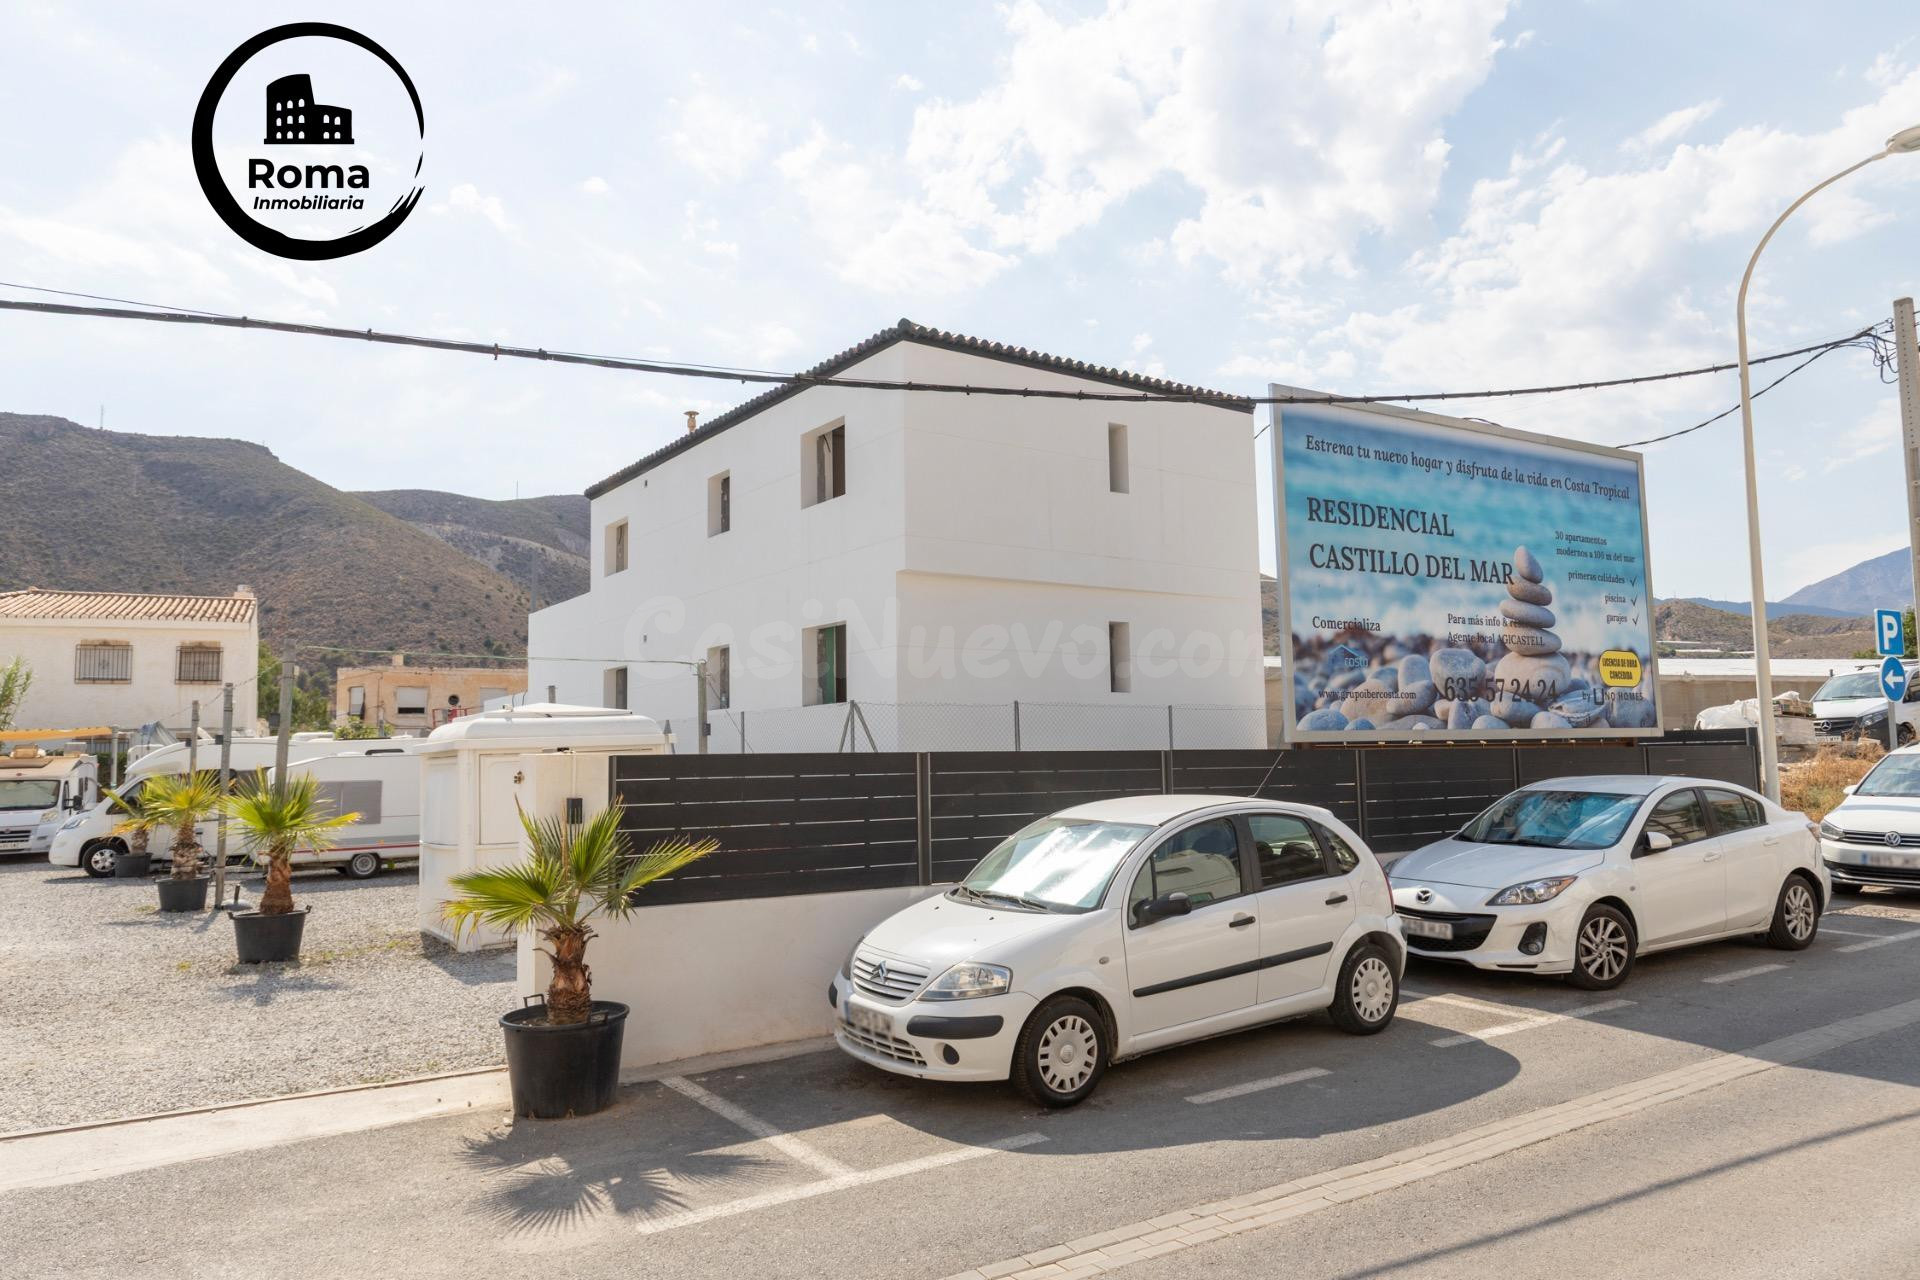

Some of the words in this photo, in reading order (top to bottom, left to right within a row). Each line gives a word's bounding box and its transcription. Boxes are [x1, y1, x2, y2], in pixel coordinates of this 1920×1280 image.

[1305, 434, 1354, 457] Estrena
[1357, 444, 1371, 459] tu
[1373, 449, 1409, 465] nuevo
[1411, 451, 1444, 473] hogar
[1446, 462, 1453, 476] y
[1456, 459, 1498, 480] disfruta
[1501, 466, 1513, 482] de
[1515, 468, 1525, 483] la
[1527, 471, 1548, 487] vida
[1550, 479, 1562, 489] en
[1564, 477, 1590, 493] Costa
[1592, 481, 1630, 500] Tropical
[1306, 496, 1455, 537] RESIDENCIAL
[1565, 533, 1607, 545] apartamentos
[1556, 547, 1588, 558] modernos
[1613, 553, 1622, 562] del
[1309, 543, 1420, 577] CASTILLO
[1425, 554, 1465, 580] DEL
[1470, 559, 1515, 585] MAR
[1568, 570, 1596, 581] primeras
[1598, 571, 1625, 584] calidades
[1605, 593, 1626, 604] piscina
[1312, 615, 1381, 631] Comercializa
[1447, 613, 1466, 625] Para
[1468, 614, 1483, 626] más
[1485, 615, 1500, 627] info
[1606, 613, 1628, 624] garajes
[1448, 631, 1474, 645] Agente
[1477, 632, 1495, 644] local
[1496, 633, 1545, 646] AGICASTELL
[1881, 614, 1899, 651] P
[1318, 689, 1417, 701] www.grupoibercosta.com
[1444, 676, 1478, 702] 635
[1485, 678, 1505, 702] 57
[1511, 678, 1533, 702] 24
[1537, 679, 1557, 702] 24
[1582, 691, 1591, 702] by
[1618, 691, 1643, 701] HOMES
